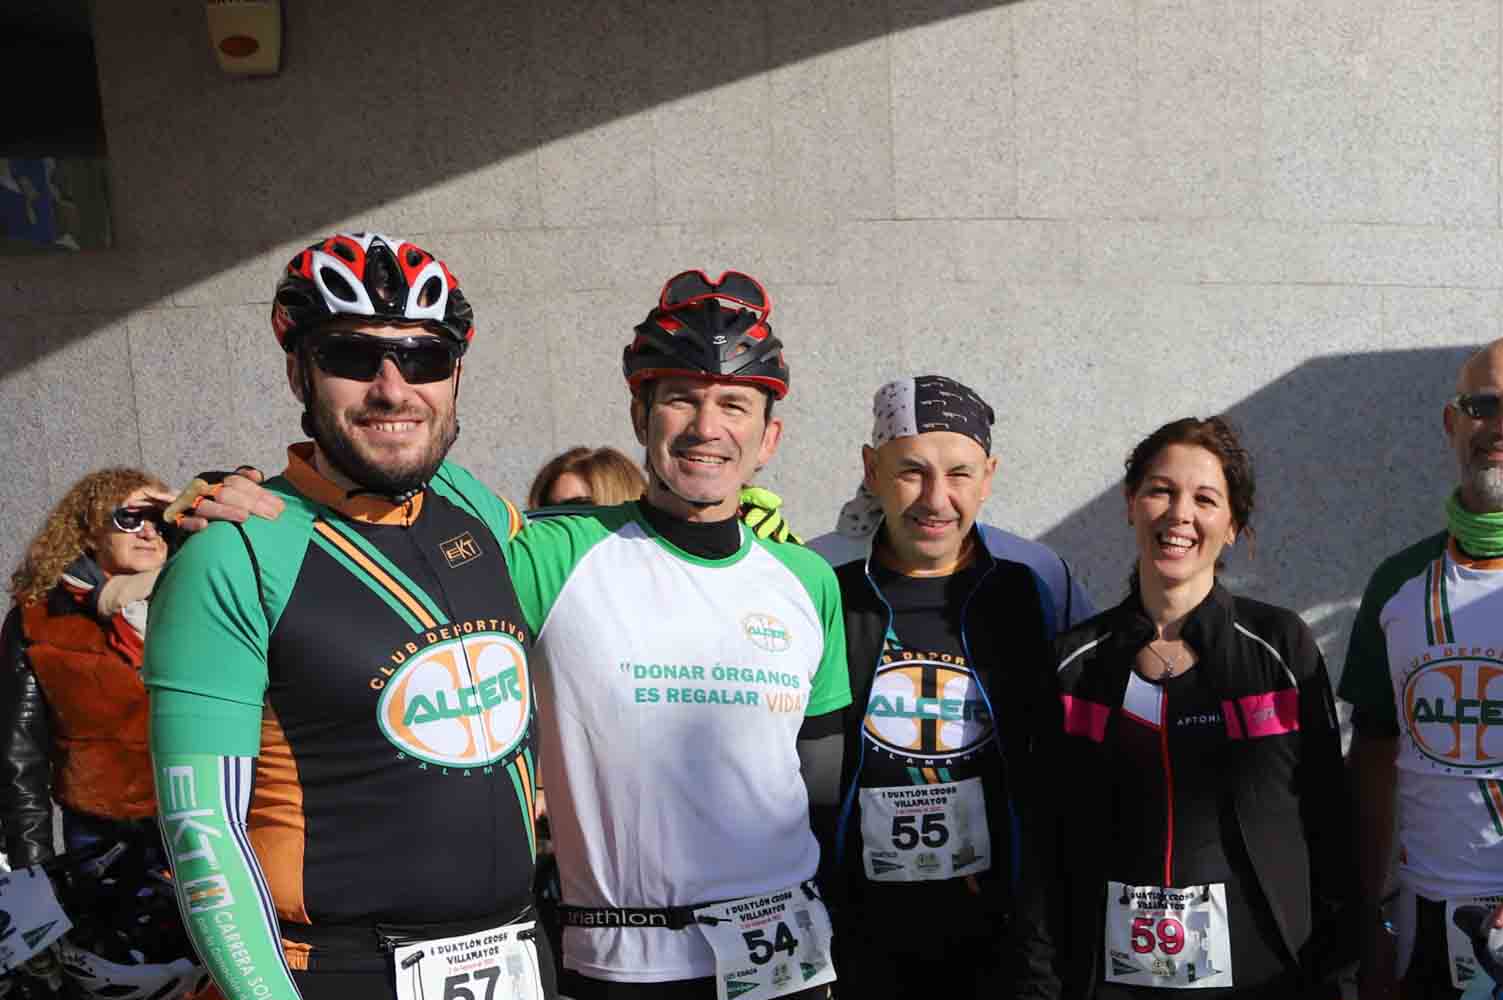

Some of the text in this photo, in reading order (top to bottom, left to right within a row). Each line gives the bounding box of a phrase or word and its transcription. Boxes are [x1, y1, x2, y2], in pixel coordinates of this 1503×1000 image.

[447, 539, 477, 560] EKT
[370, 619, 526, 691] CLUB DEPORTIVO
[711, 661, 800, 689] ÓRGANOS
[403, 666, 522, 727] ALCER
[635, 687, 661, 704] ES
[666, 687, 759, 706] REGALAR
[163, 765, 222, 871] EKT
[894, 797, 948, 808] VILLAMAYOR
[891, 813, 949, 851] 55
[739, 903, 786, 923] VILLAMAYOR
[212, 909, 256, 978] CARRERA
[483, 932, 508, 946] CROSS
[742, 921, 799, 966] 54
[1131, 917, 1185, 955] 59
[446, 946, 500, 965] VILLAMAYOR
